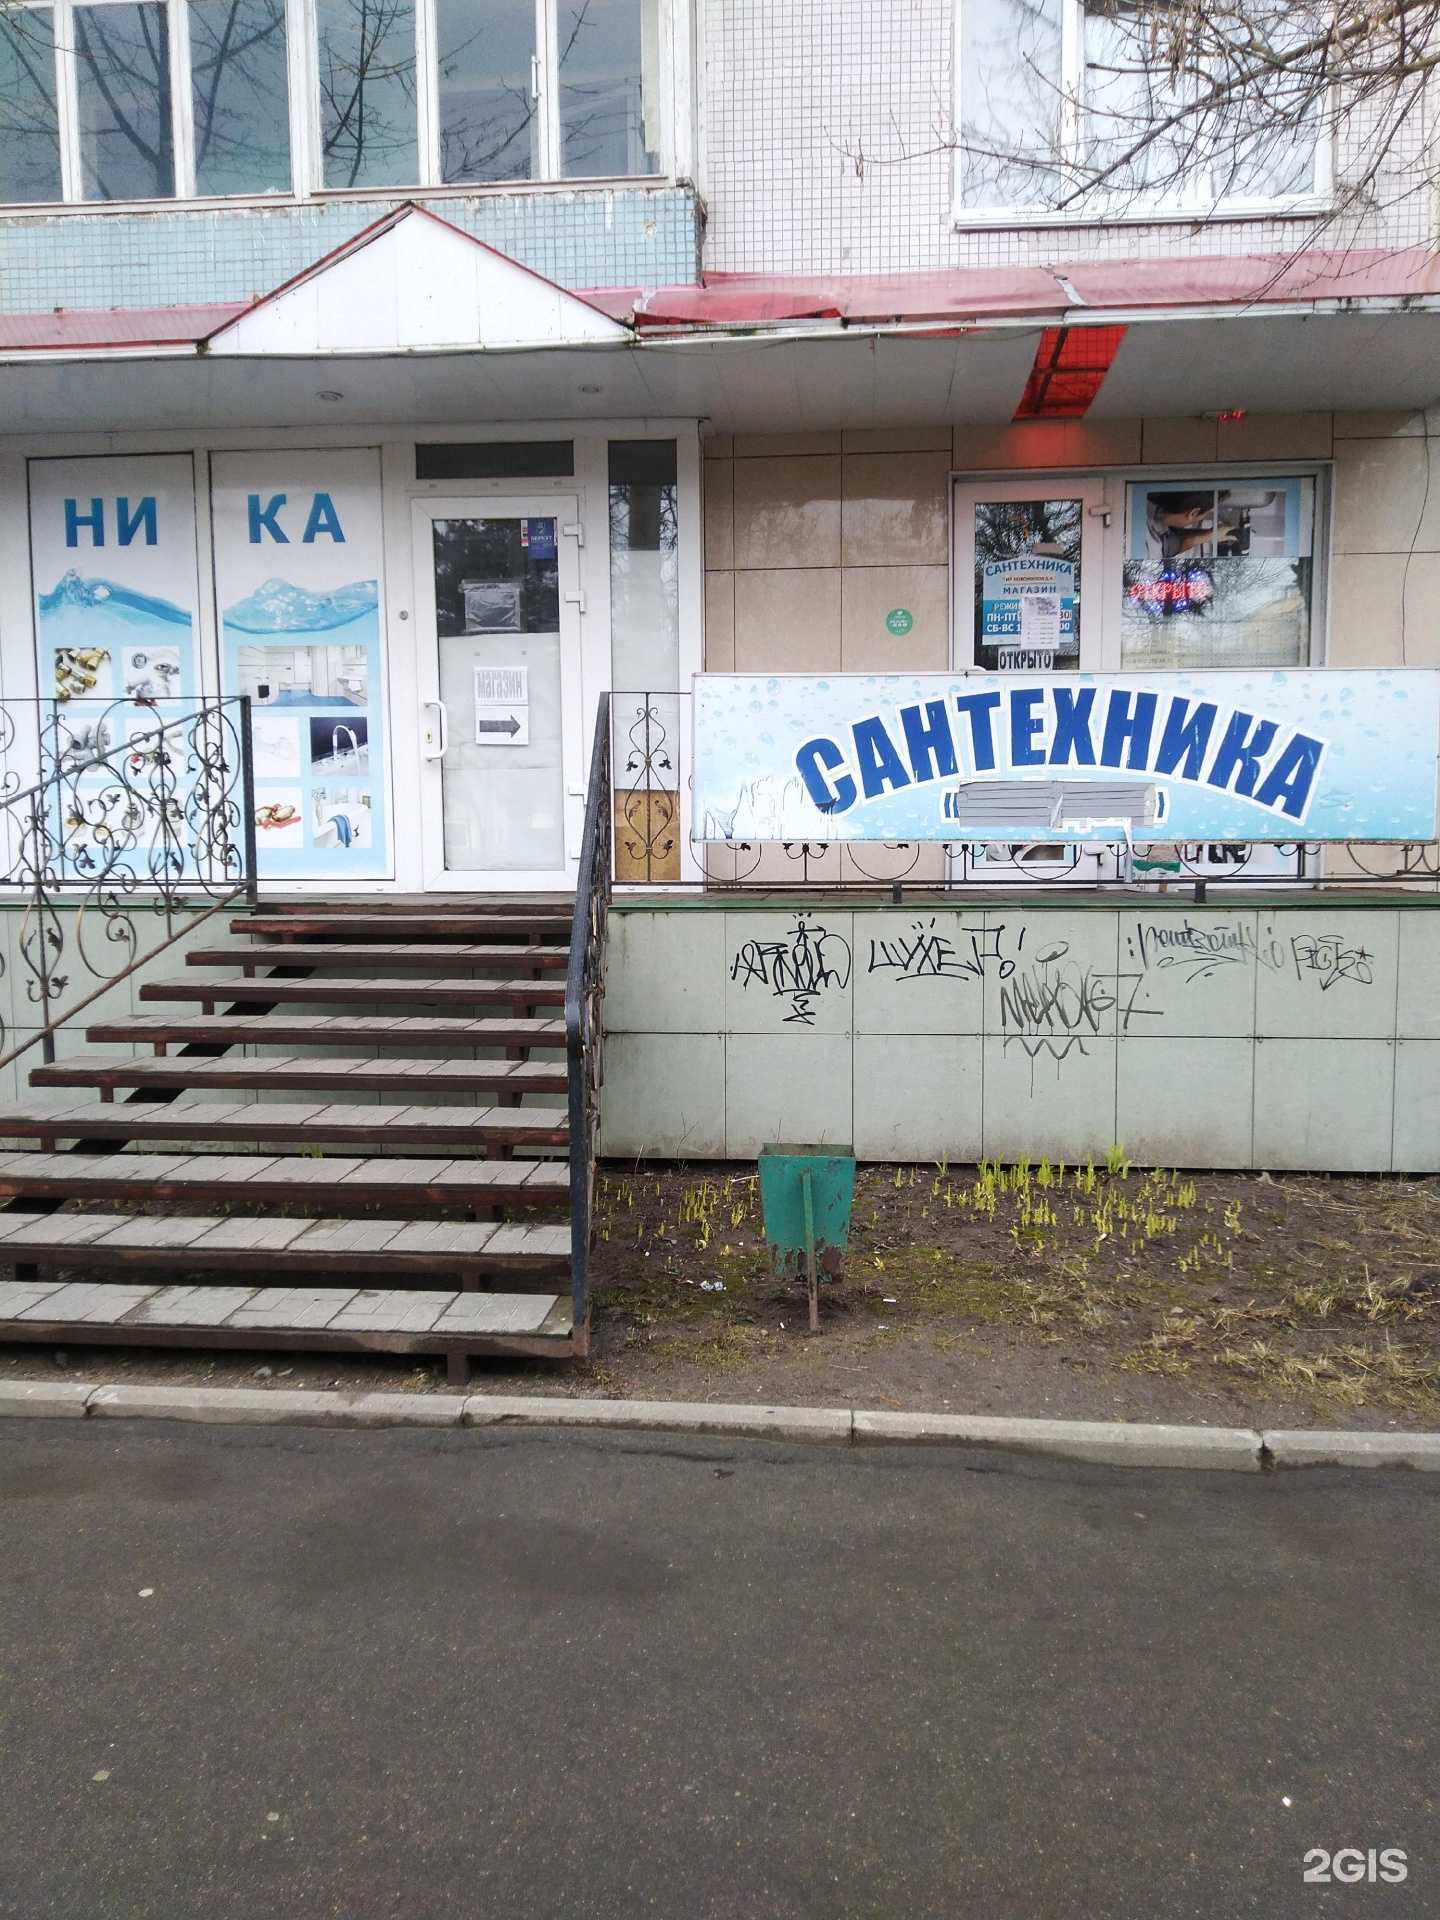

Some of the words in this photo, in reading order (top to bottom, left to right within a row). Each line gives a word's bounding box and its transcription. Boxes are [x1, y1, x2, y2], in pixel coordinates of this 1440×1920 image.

[64, 497, 158, 548] НИ
[247, 492, 346, 544] КА
[985, 559, 1072, 577] САНТЕХНИКА
[1003, 586, 1057, 595] МАГАЗИН
[994, 601, 1022, 611] РЕЖИ
[986, 623, 1015, 632] СБ-ВС
[999, 651, 1053, 670] ОТКРЫТО
[795, 687, 1326, 820] САНТЕХНИКА
